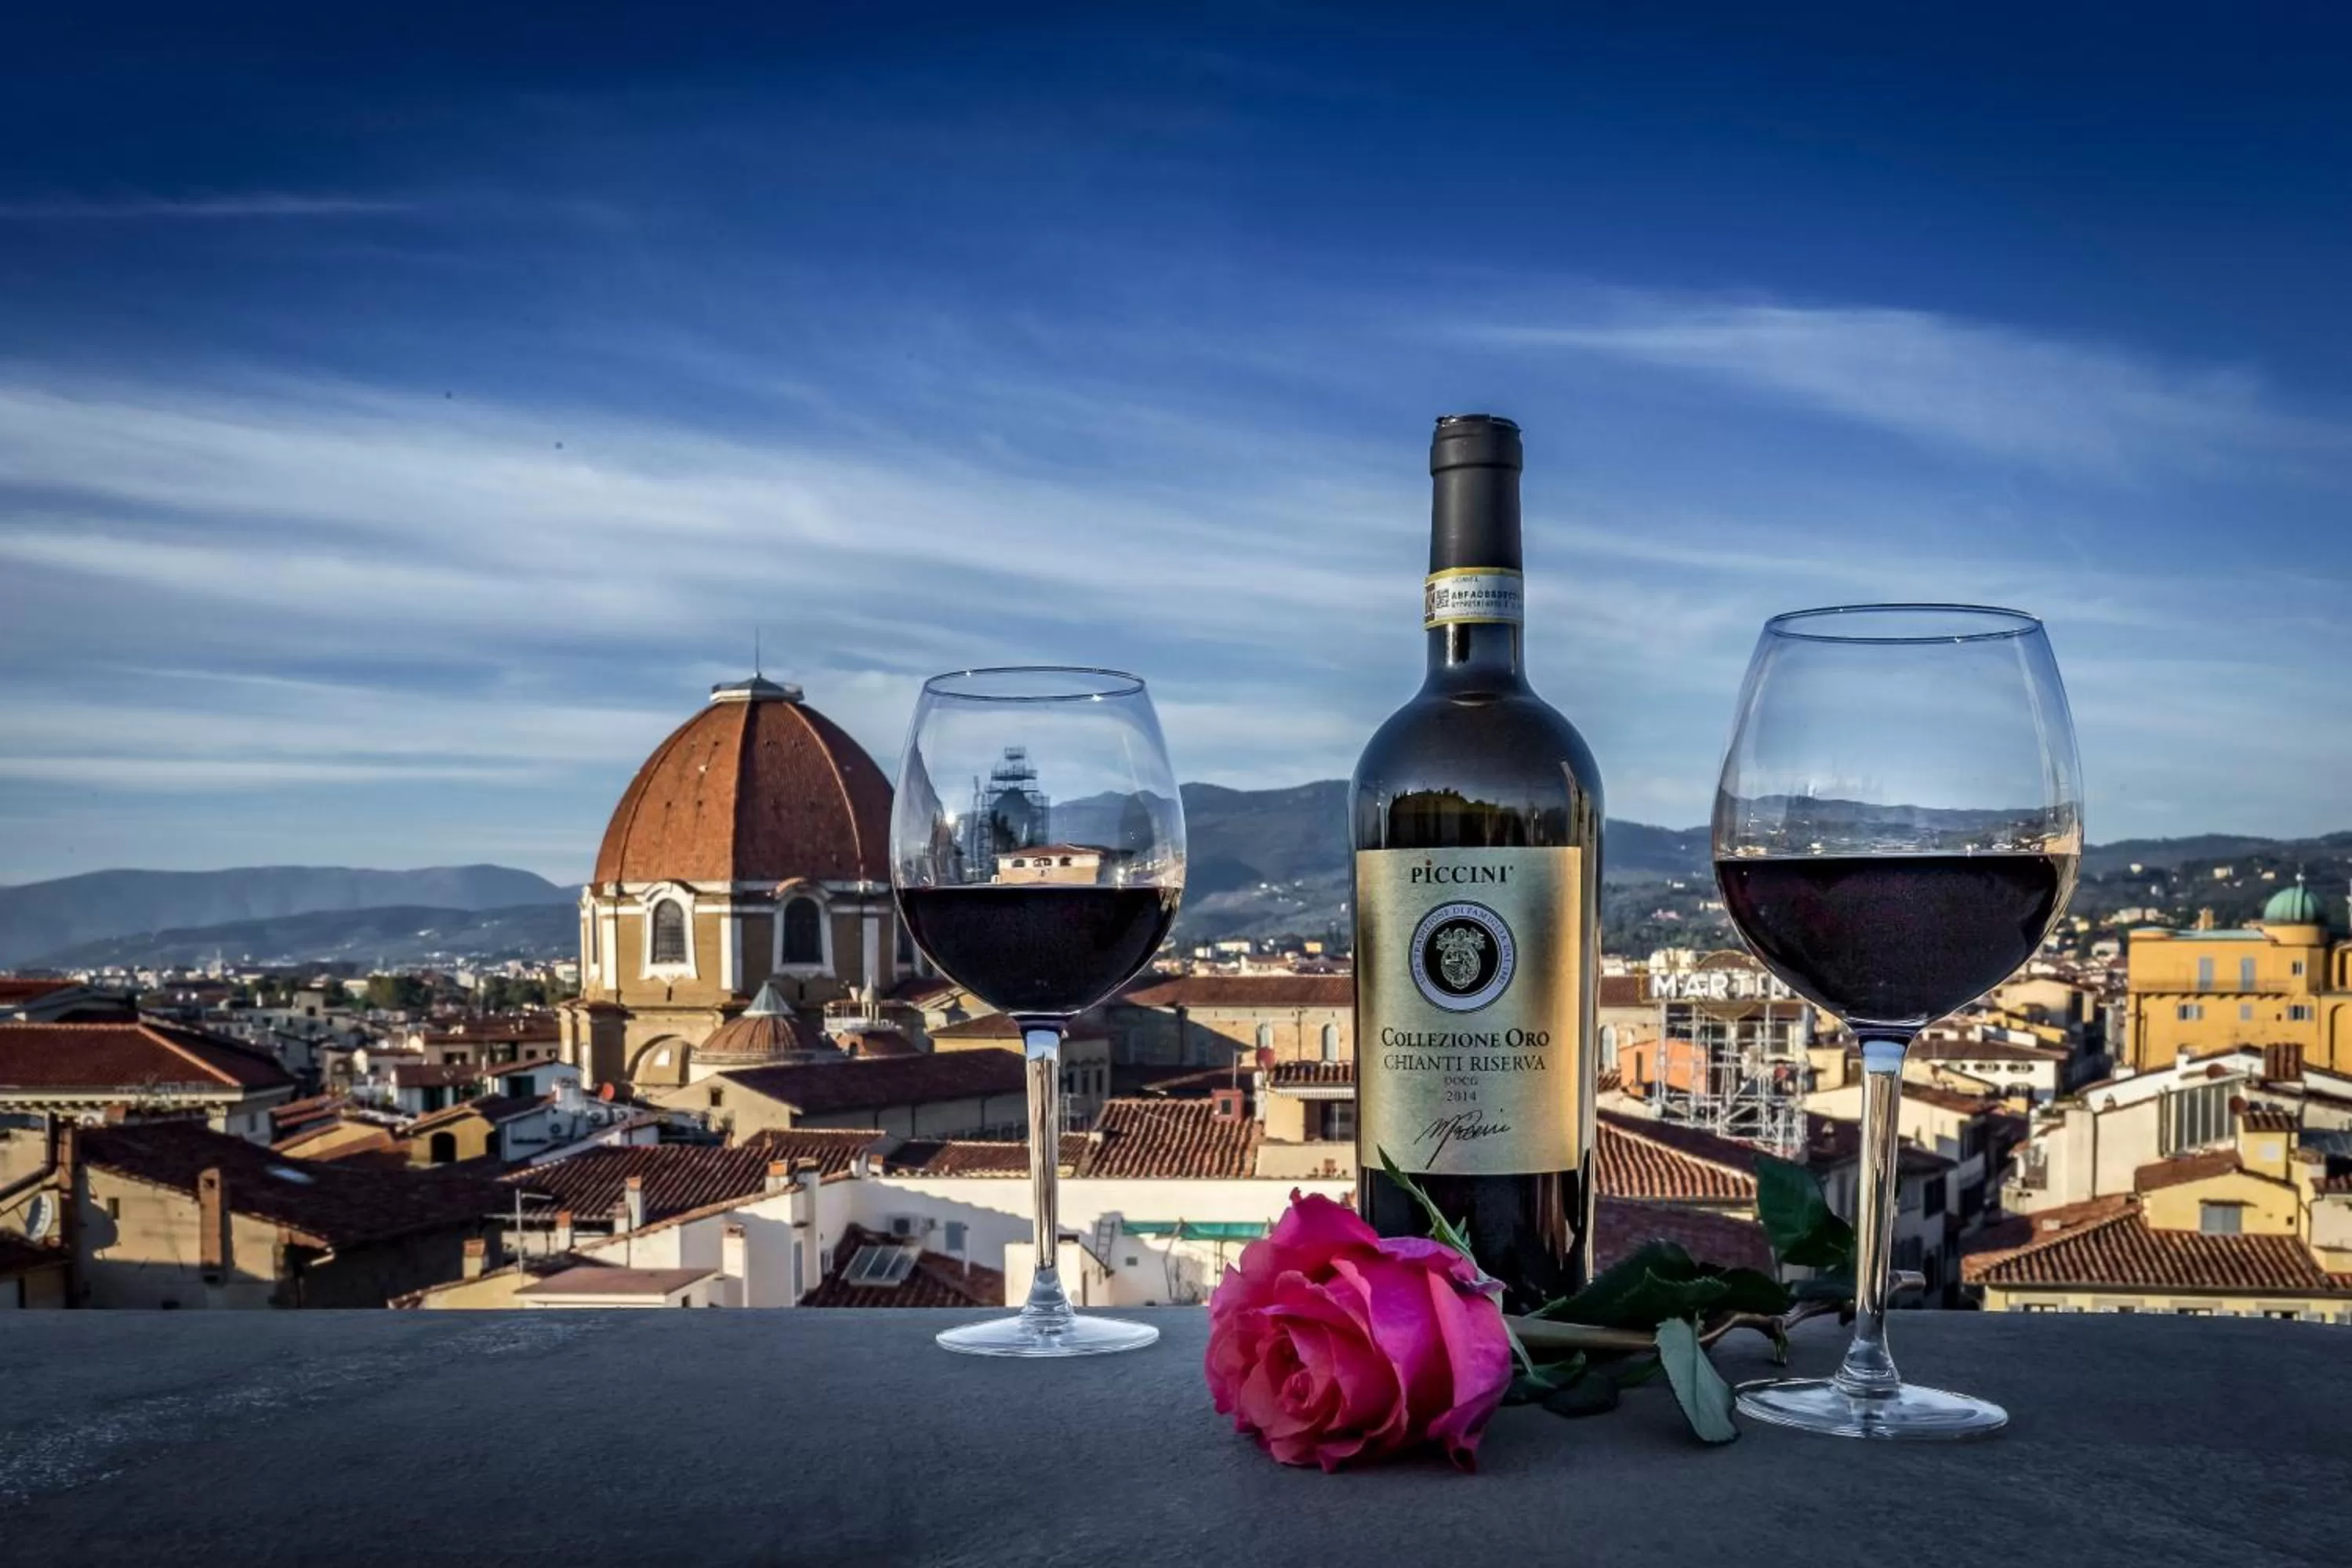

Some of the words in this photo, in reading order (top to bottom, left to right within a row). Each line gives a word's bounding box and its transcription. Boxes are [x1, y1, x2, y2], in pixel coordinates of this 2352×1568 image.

[1410, 859, 1507, 884] PICCINI
[1651, 972, 1791, 1001] MARTIN
[1384, 1054, 1462, 1072] CHIANTI
[1470, 1054, 1546, 1073] RISERVA
[1443, 1075, 1479, 1086] DOCG
[1446, 1091, 1477, 1102] 2014
